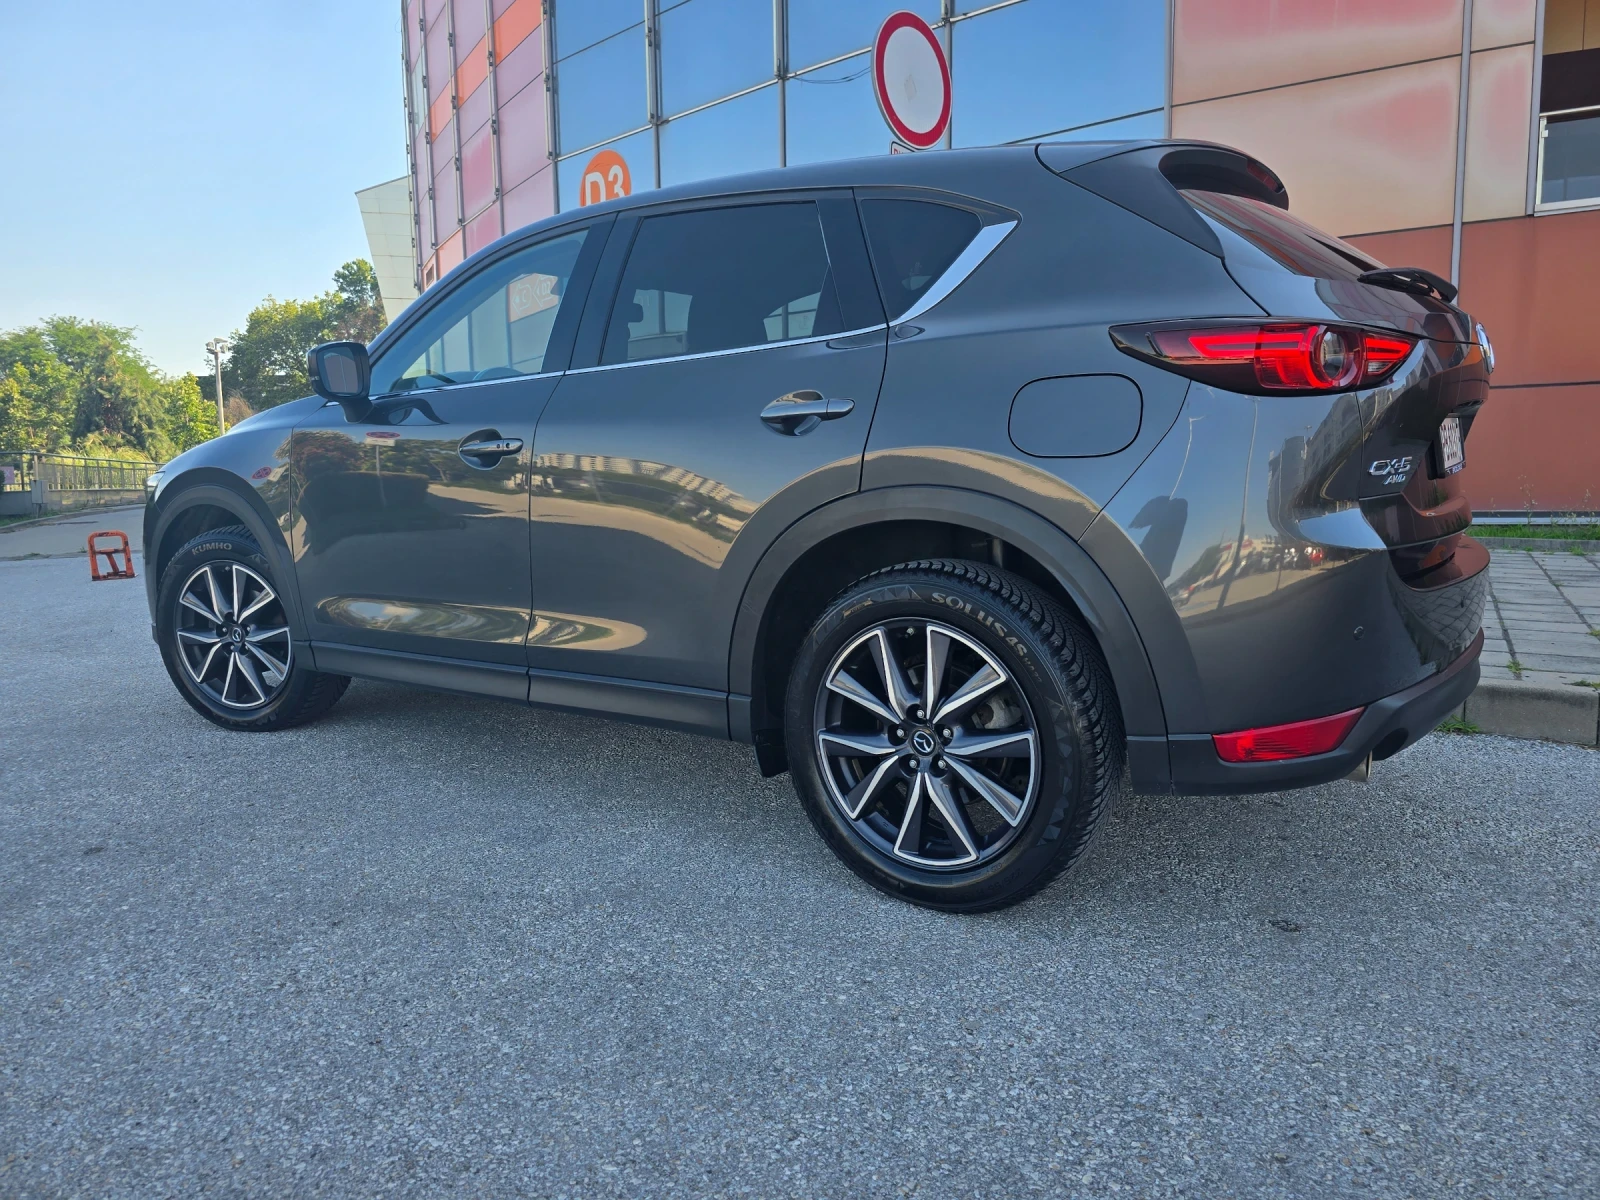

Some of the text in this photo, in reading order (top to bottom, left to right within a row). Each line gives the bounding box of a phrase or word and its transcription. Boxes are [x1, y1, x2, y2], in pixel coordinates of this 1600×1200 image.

[585, 165, 626, 206] D3
[1368, 456, 1413, 476] CX-5
[1383, 473, 1406, 485] AWD
[191, 542, 233, 556] KUMHO
[931, 592, 1008, 637] SOLUS
[1005, 636, 1028, 657] 4S
